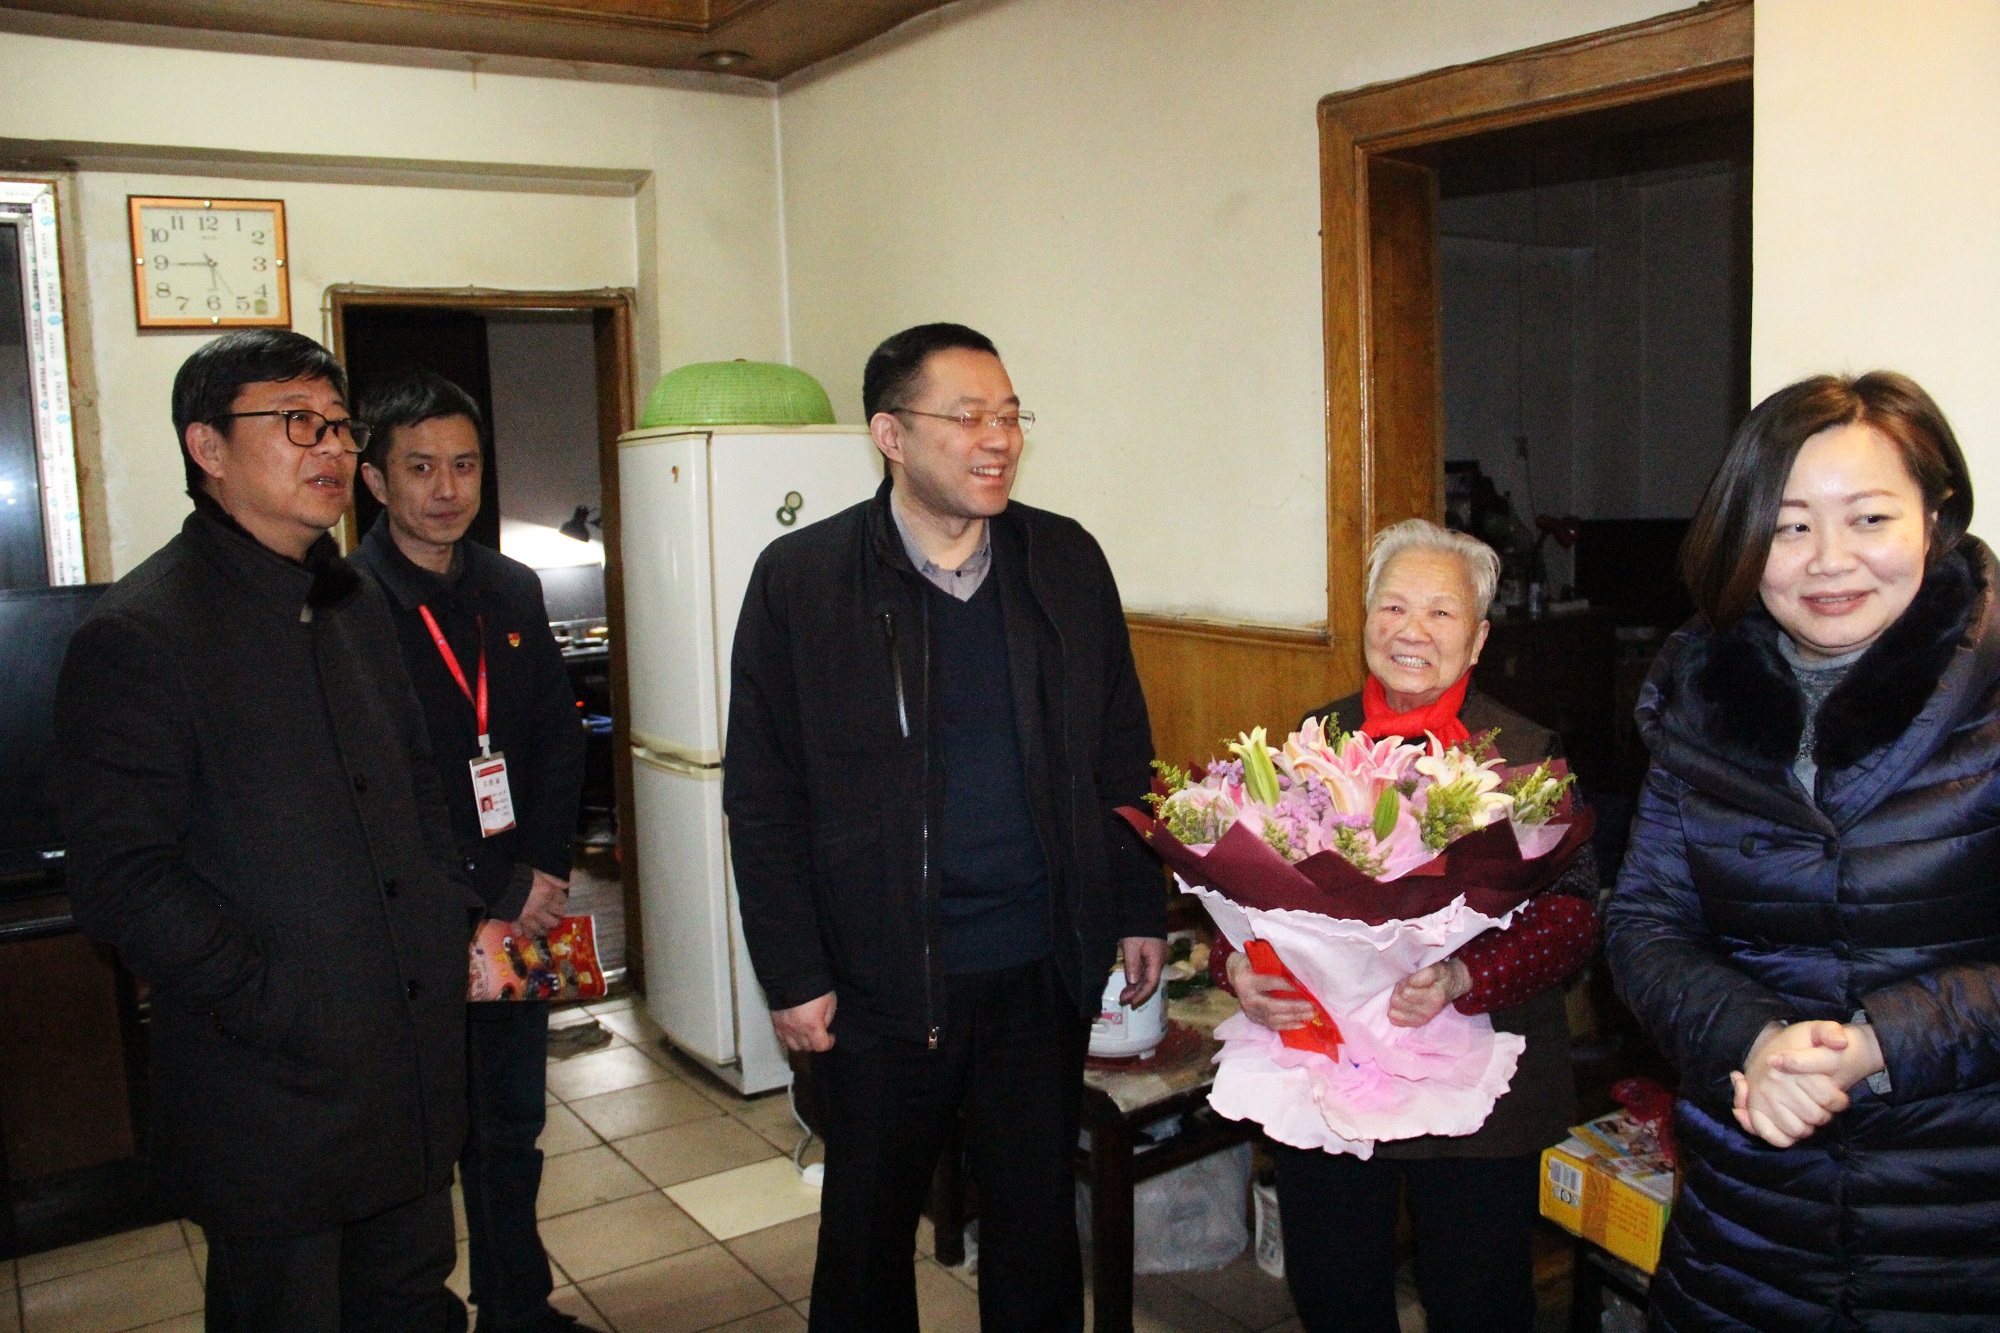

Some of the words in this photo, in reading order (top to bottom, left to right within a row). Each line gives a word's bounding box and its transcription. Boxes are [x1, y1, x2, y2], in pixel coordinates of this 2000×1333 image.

[171, 216, 184, 230] 11
[198, 216, 218, 231] 12
[235, 217, 241, 231] 1
[151, 228, 169, 243] 10
[252, 231, 265, 245] 2
[154, 255, 169, 270] 9
[253, 256, 267, 271] 3
[156, 282, 171, 298] 8
[254, 284, 267, 298] 4
[176, 296, 189, 310] 7
[206, 295, 221, 310] 6
[236, 296, 250, 311] 5
